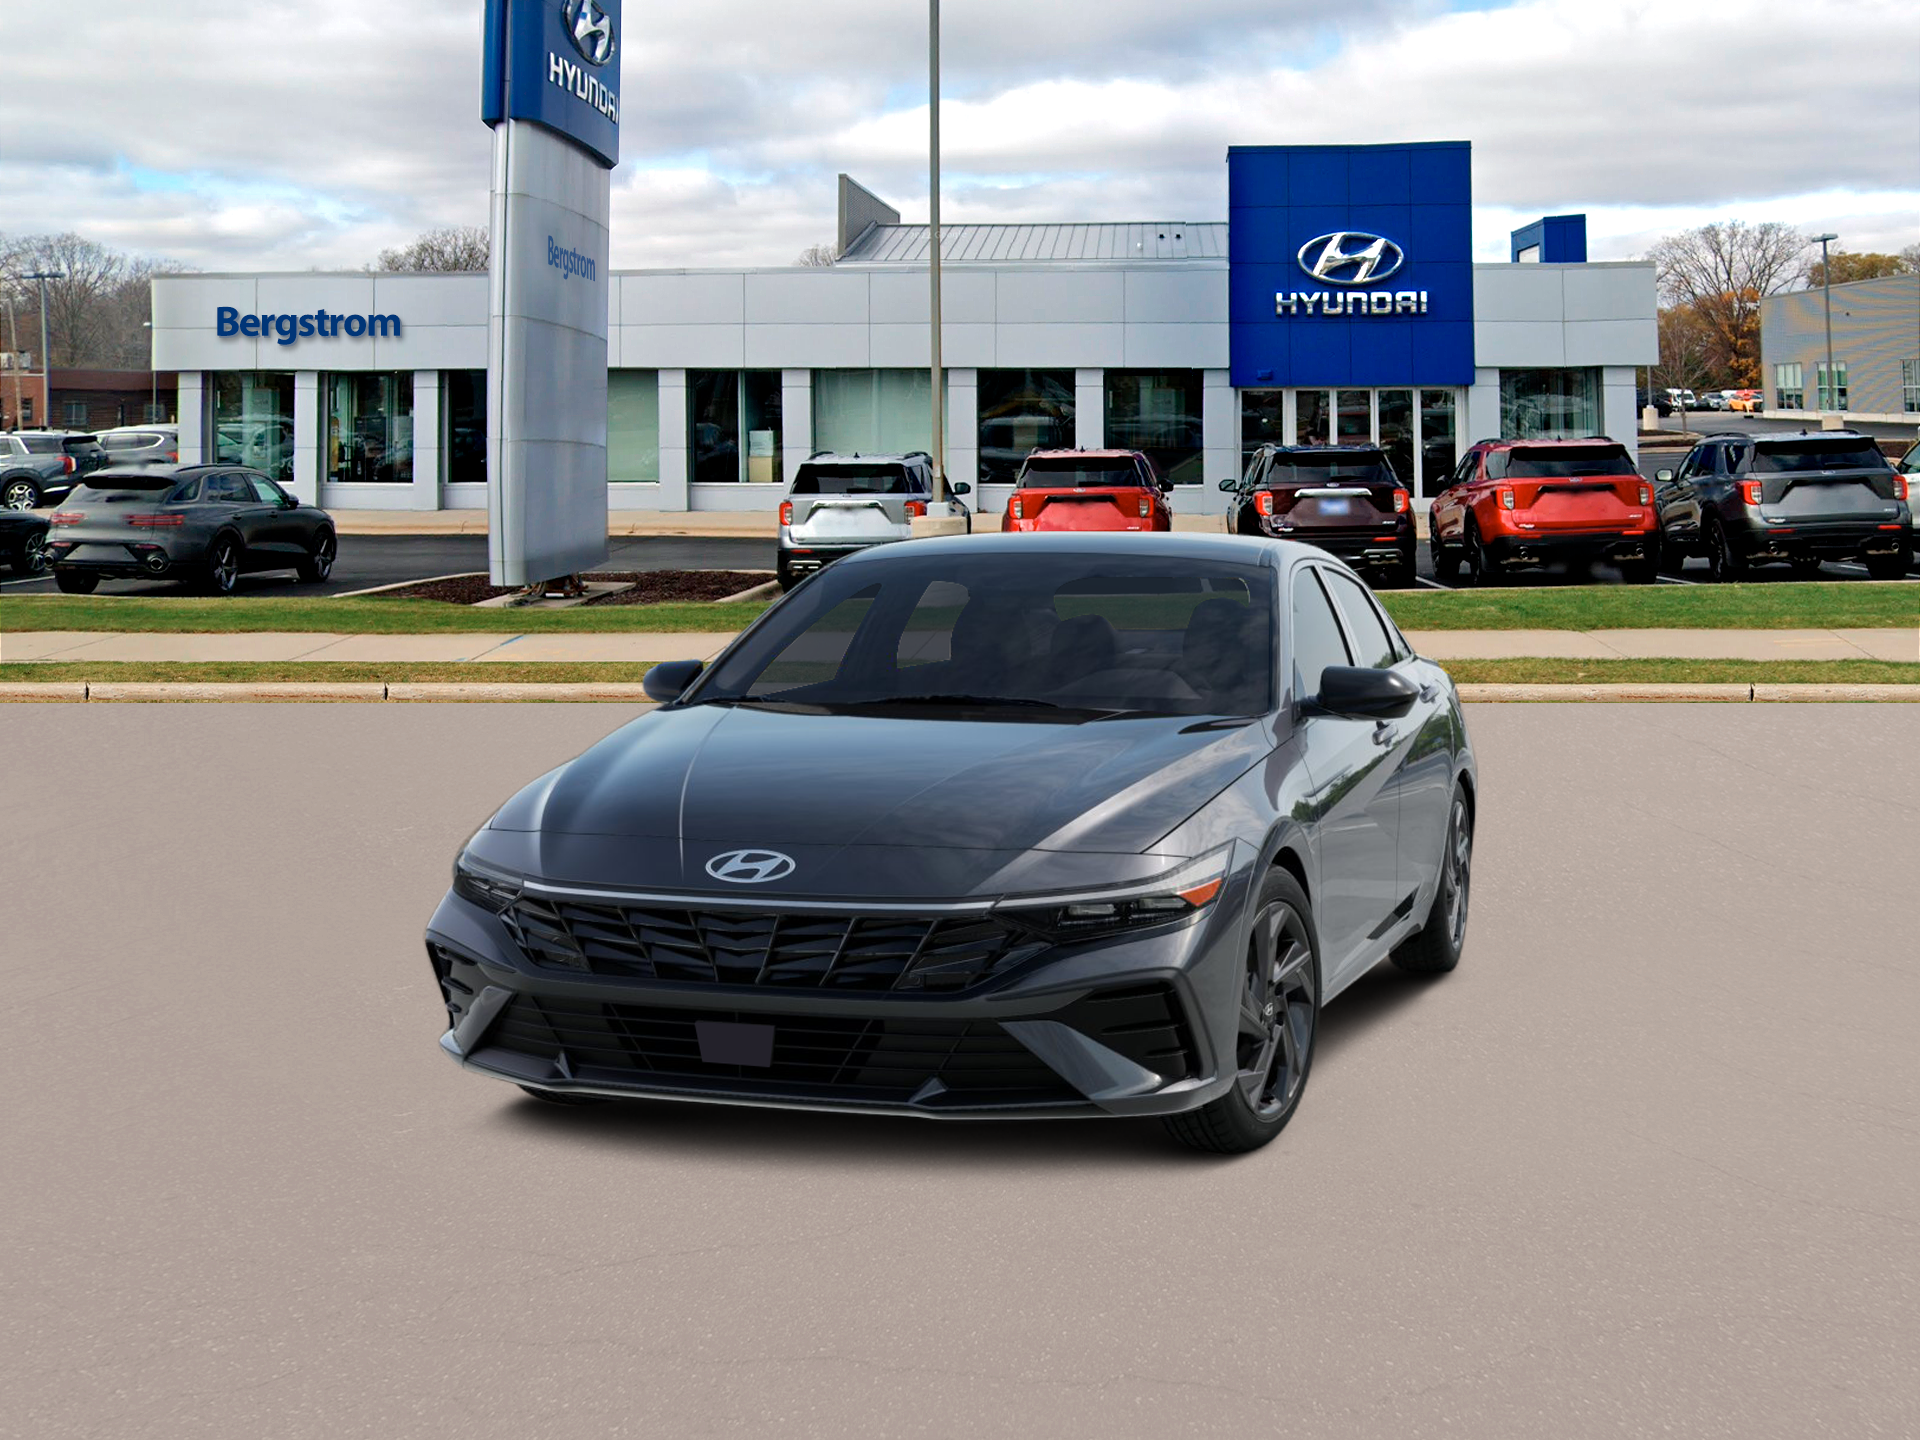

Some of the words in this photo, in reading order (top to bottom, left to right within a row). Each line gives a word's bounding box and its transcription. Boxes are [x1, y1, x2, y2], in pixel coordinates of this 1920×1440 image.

[549, 52, 619, 124] HYUNDAI
[547, 235, 596, 282] Bergstrom
[1275, 290, 1428, 315] HYUNDAI
[217, 306, 402, 346] Bergstrom
